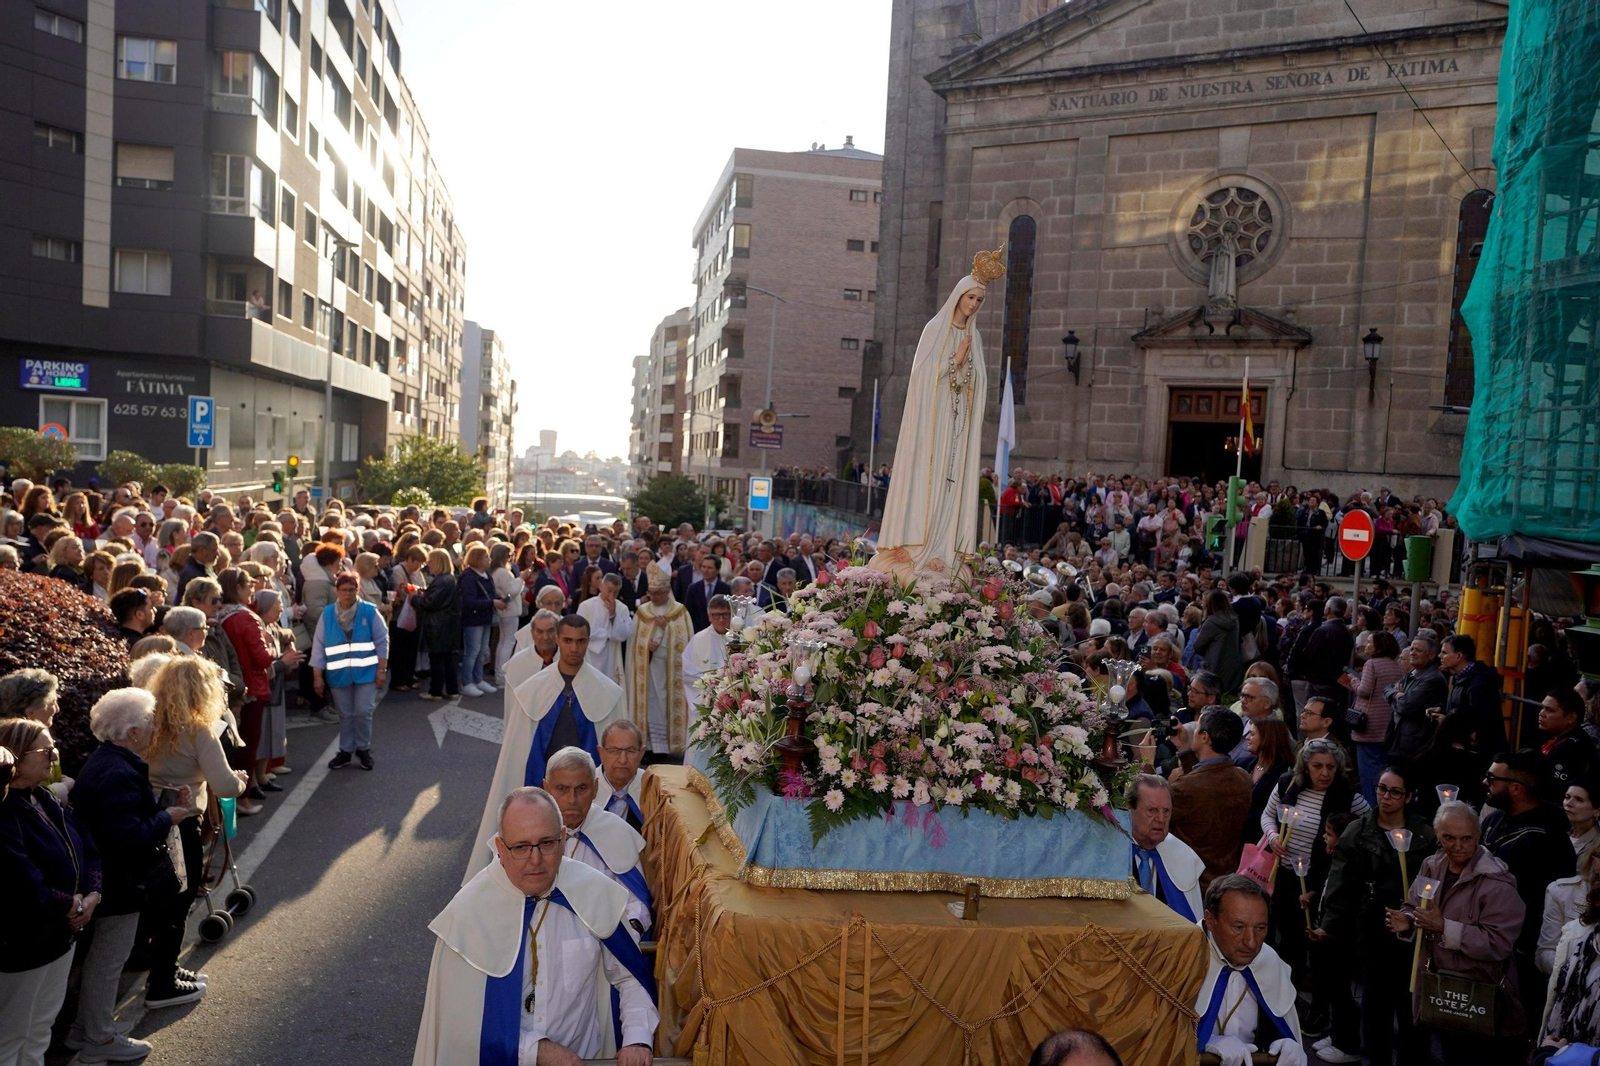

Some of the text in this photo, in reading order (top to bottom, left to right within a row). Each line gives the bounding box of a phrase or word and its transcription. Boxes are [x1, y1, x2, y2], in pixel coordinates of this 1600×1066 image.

[1050, 90, 1138, 112] SANTUARIO
[1149, 87, 1168, 102] DE
[1178, 79, 1254, 100] NUESTRA
[1266, 70, 1334, 91] SEÑORA
[1347, 66, 1370, 83] DE
[25, 359, 84, 373] PARKING
[32, 368, 79, 379] 24 HORAS
[116, 369, 164, 380] Apartamentos
[54, 376, 81, 388] LIBRE
[126, 378, 184, 396] FÁTIMA
[113, 403, 139, 416] 625
[141, 405, 158, 417] 57
[160, 406, 177, 418] 63
[195, 401, 209, 422] P
[1554, 771, 1568, 780] SC
[1444, 990, 1469, 1002] THE
[1429, 995, 1486, 1015] TOTE BAG
